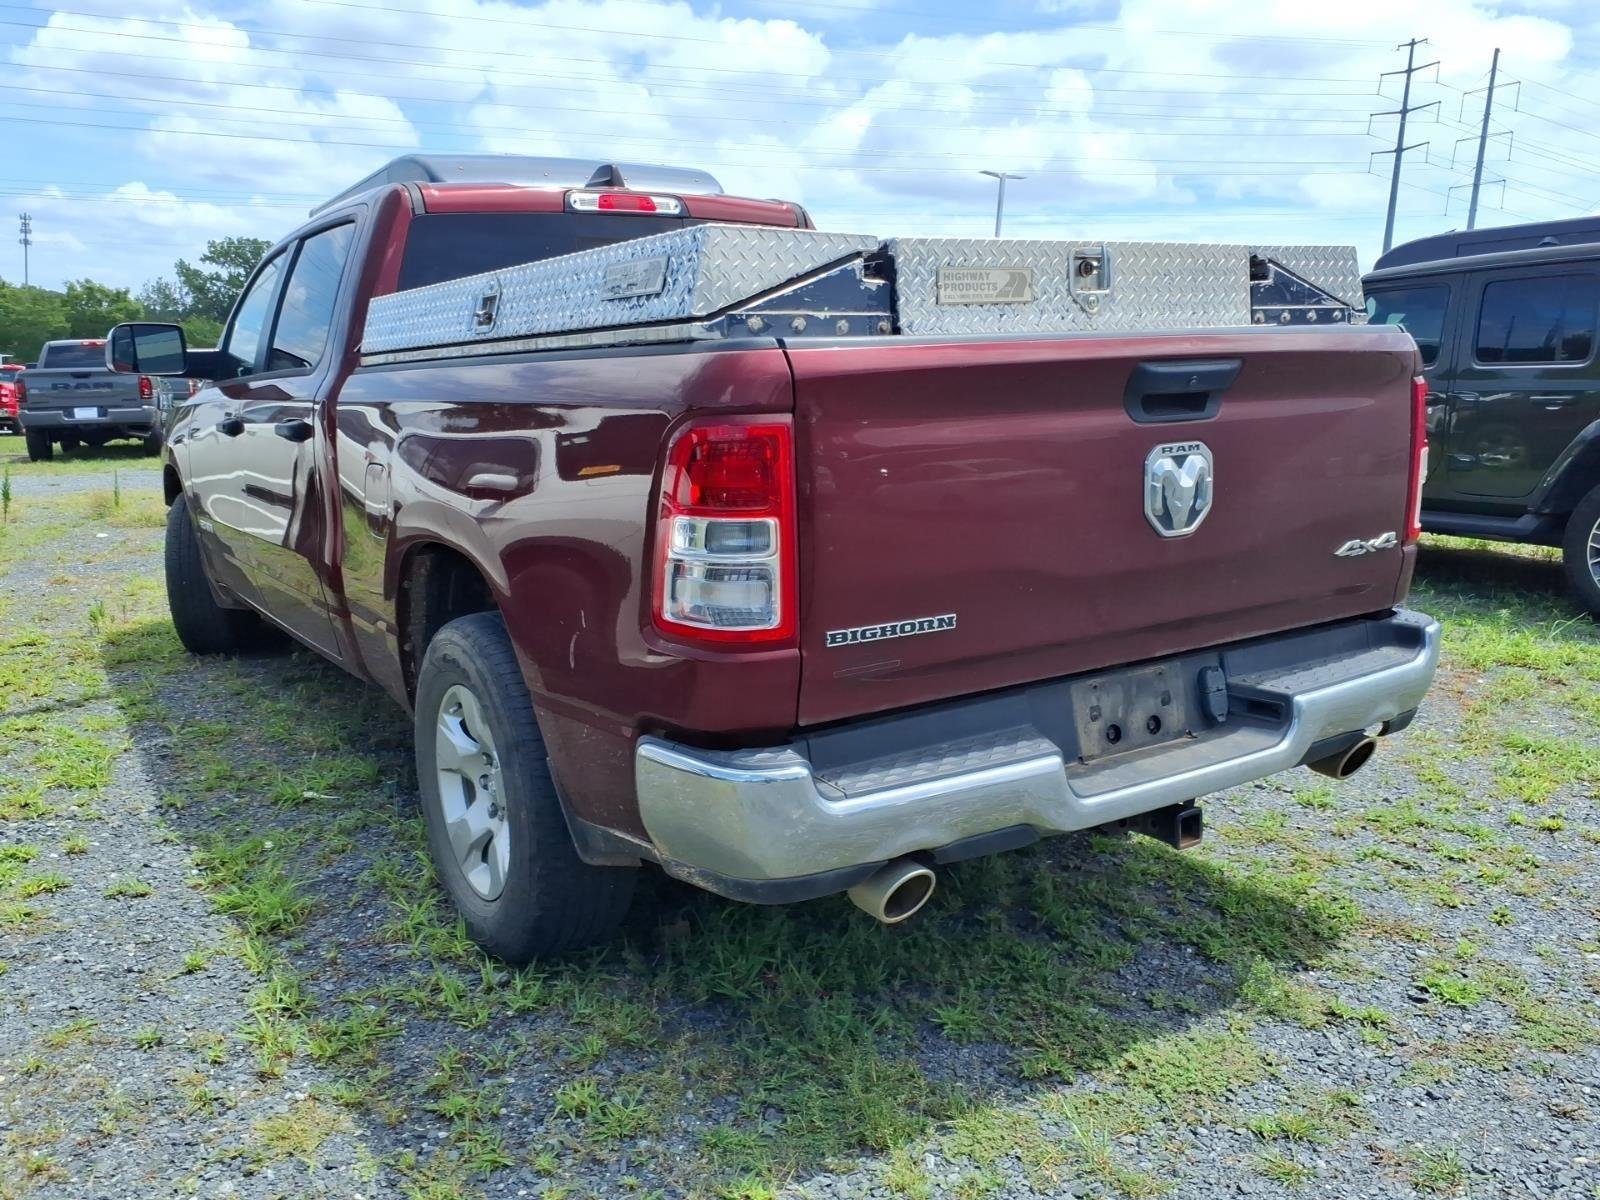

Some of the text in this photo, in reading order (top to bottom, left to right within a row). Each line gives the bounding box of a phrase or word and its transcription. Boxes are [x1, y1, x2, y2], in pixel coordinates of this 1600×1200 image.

[943, 271, 991, 281] HIGHWAY
[943, 282, 998, 292] PRODUCTS
[51, 382, 113, 390] RAM
[1161, 444, 1200, 454] RAM
[826, 613, 957, 648] BIGHORN
